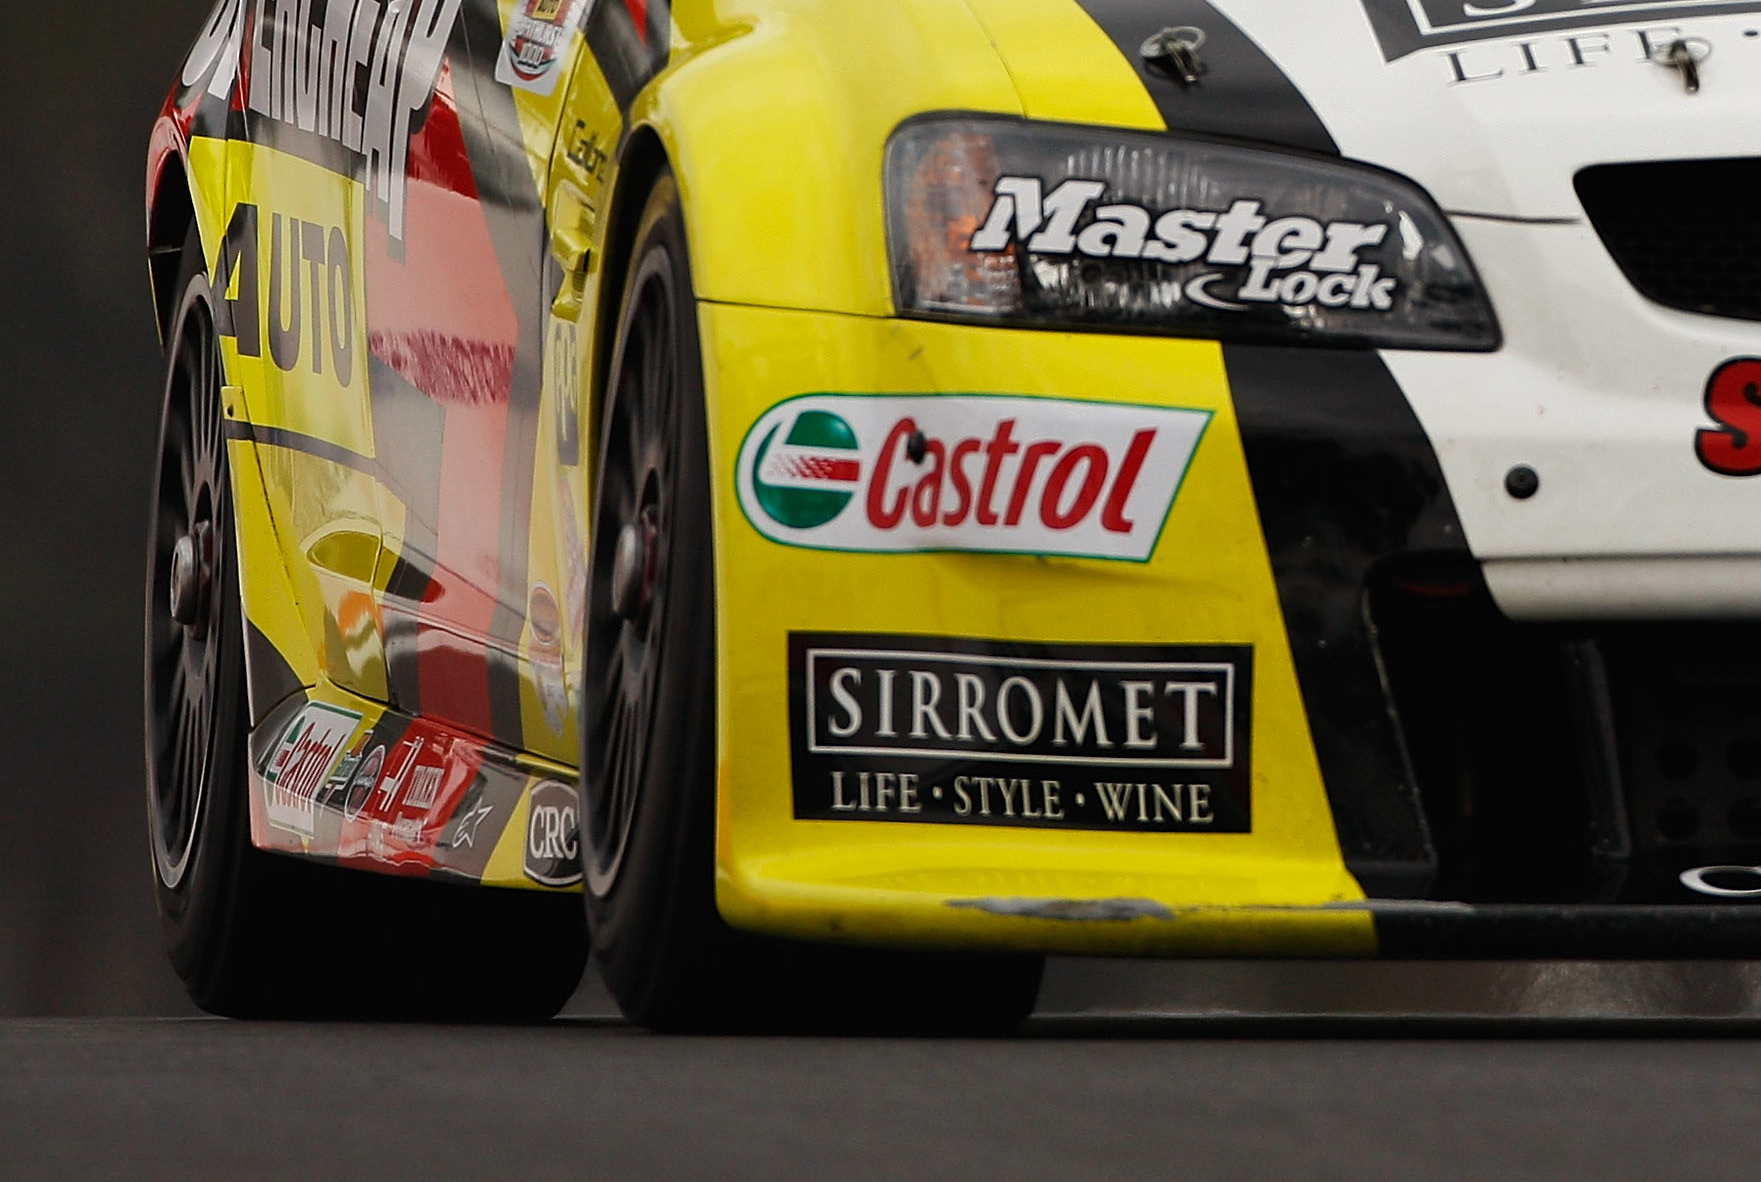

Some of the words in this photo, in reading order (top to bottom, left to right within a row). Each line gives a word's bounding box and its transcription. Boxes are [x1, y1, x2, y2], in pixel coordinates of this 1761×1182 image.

[970, 177, 1388, 272] Master
[219, 202, 352, 388] AUTO
[1242, 256, 1396, 311] Lock
[865, 417, 1159, 534] Castrol
[828, 667, 1218, 751] SIRROMET
[275, 721, 348, 802] Castrol
[832, 771, 922, 813] LIFE
[954, 775, 1064, 818] STYLE
[1094, 782, 1215, 823] WINE
[530, 805, 578, 860] CRC
